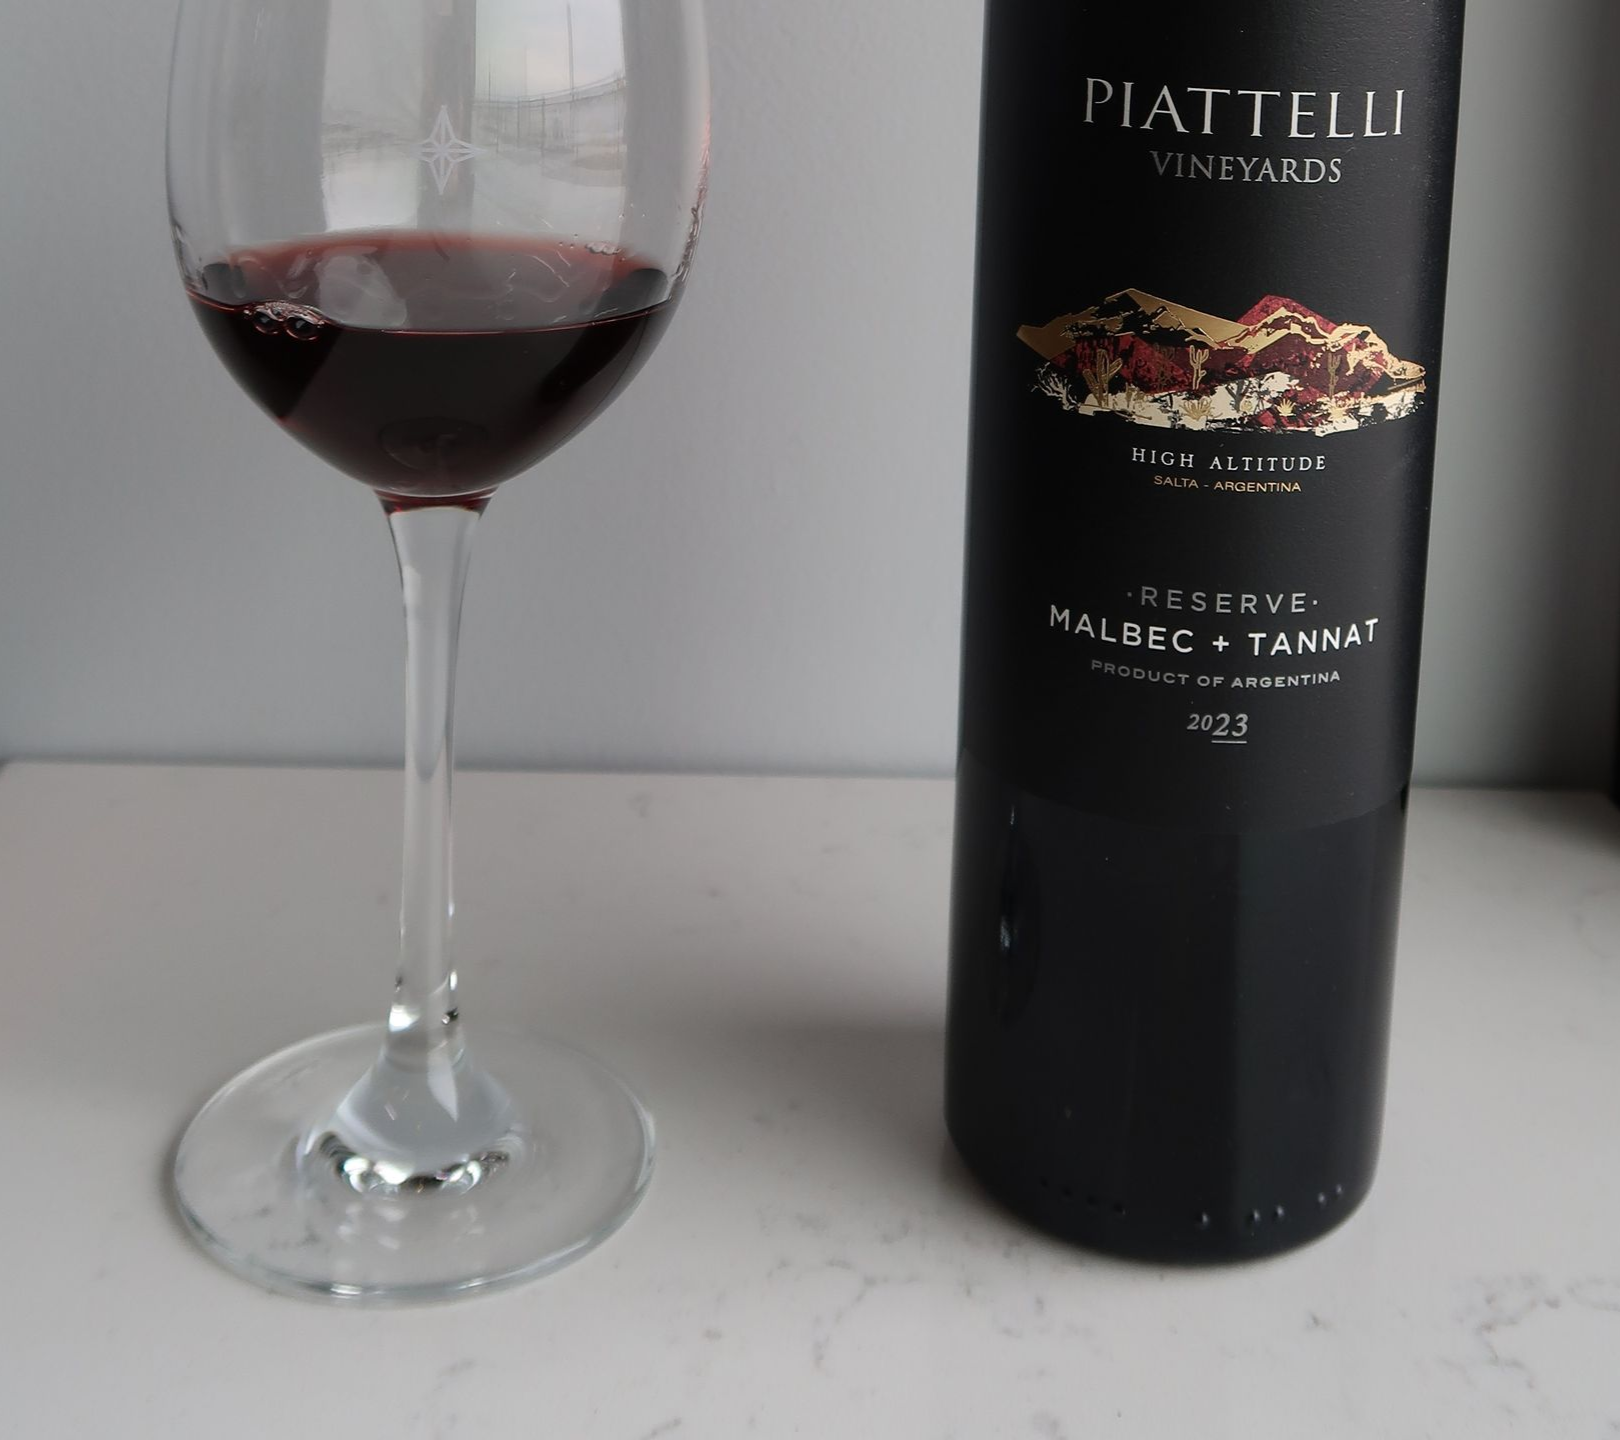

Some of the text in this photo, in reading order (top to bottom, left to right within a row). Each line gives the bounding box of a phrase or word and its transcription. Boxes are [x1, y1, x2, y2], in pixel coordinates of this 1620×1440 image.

[1083, 77, 1405, 139] PIATTELLI
[1150, 150, 1343, 184] VINEYARDS
[1132, 447, 1326, 472] HIGH ALTITUDE
[1153, 475, 1199, 489] SALTA
[1213, 481, 1302, 493] ARGENTINA
[1049, 604, 1379, 657] MALBEC + TANNAT
[1091, 659, 1341, 688] PRODUCT OF ARGENTINA
[1186, 713, 1249, 737] 2023
